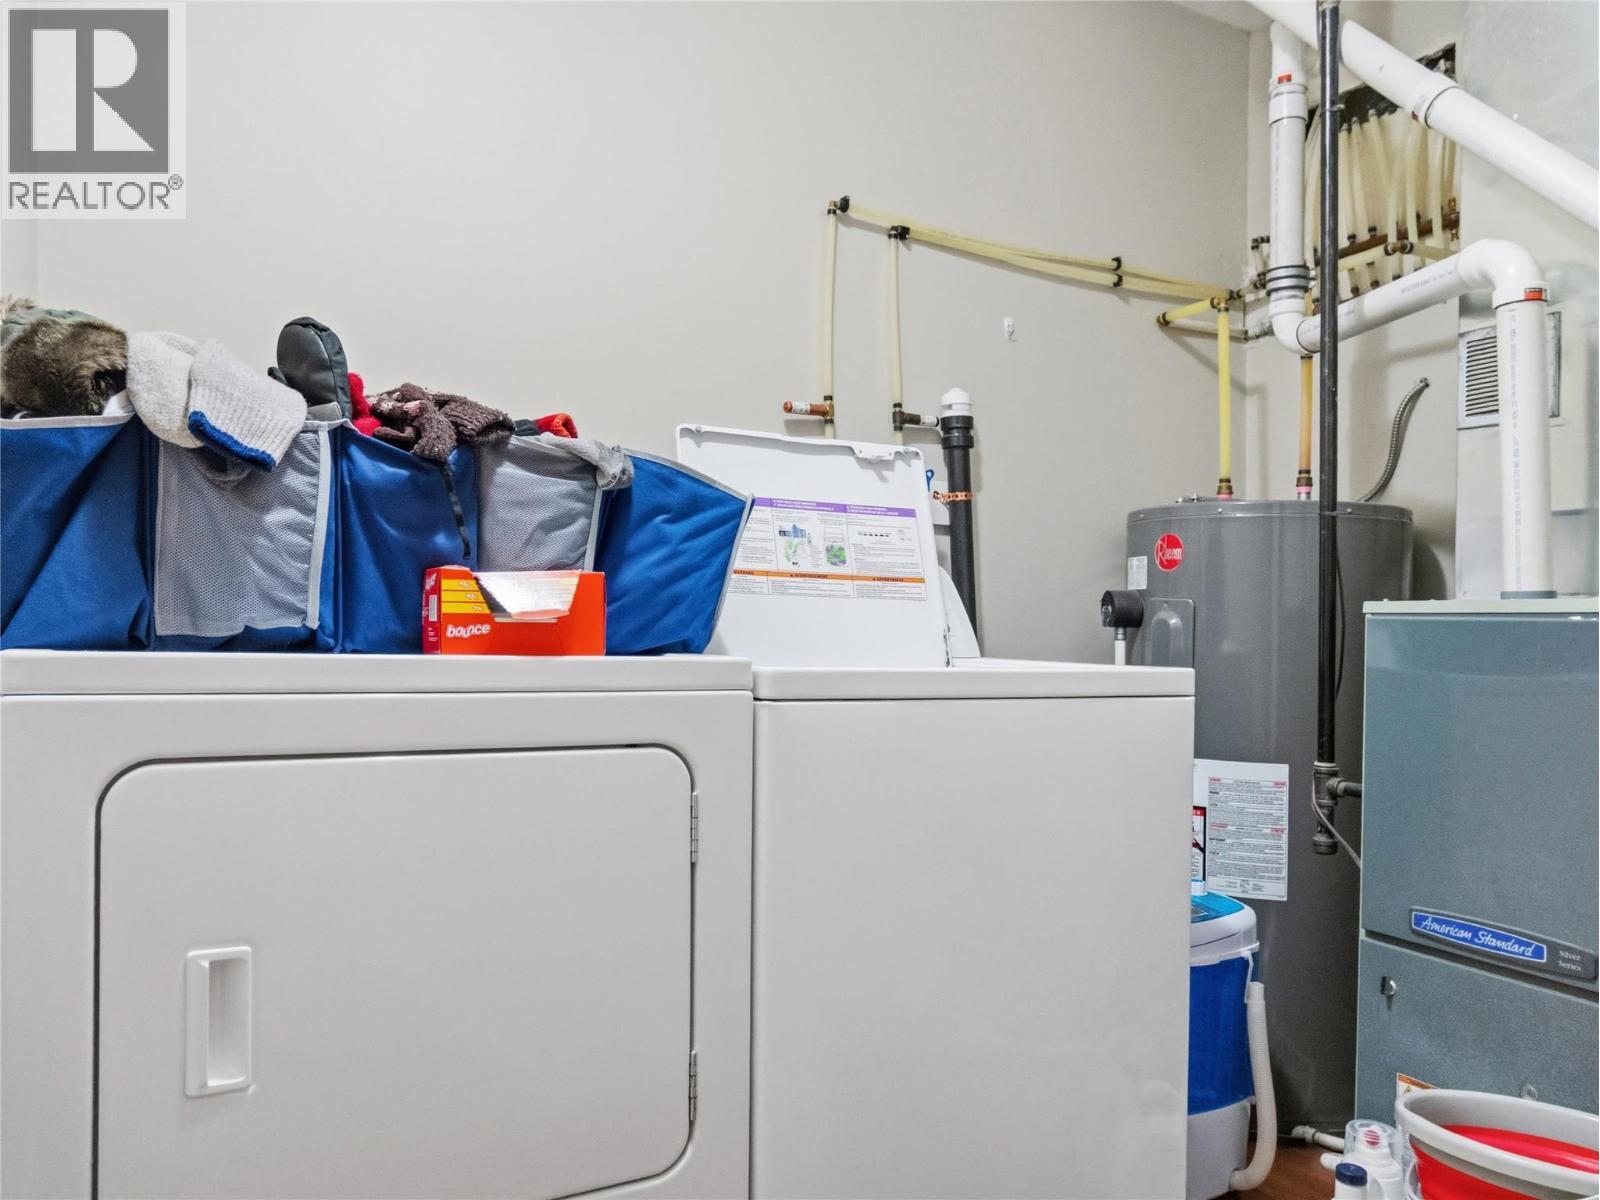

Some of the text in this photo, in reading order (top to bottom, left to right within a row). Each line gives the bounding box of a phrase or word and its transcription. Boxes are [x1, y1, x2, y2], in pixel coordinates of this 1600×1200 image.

[447, 624, 490, 638] bounce
[1420, 917, 1535, 957] American Standard
